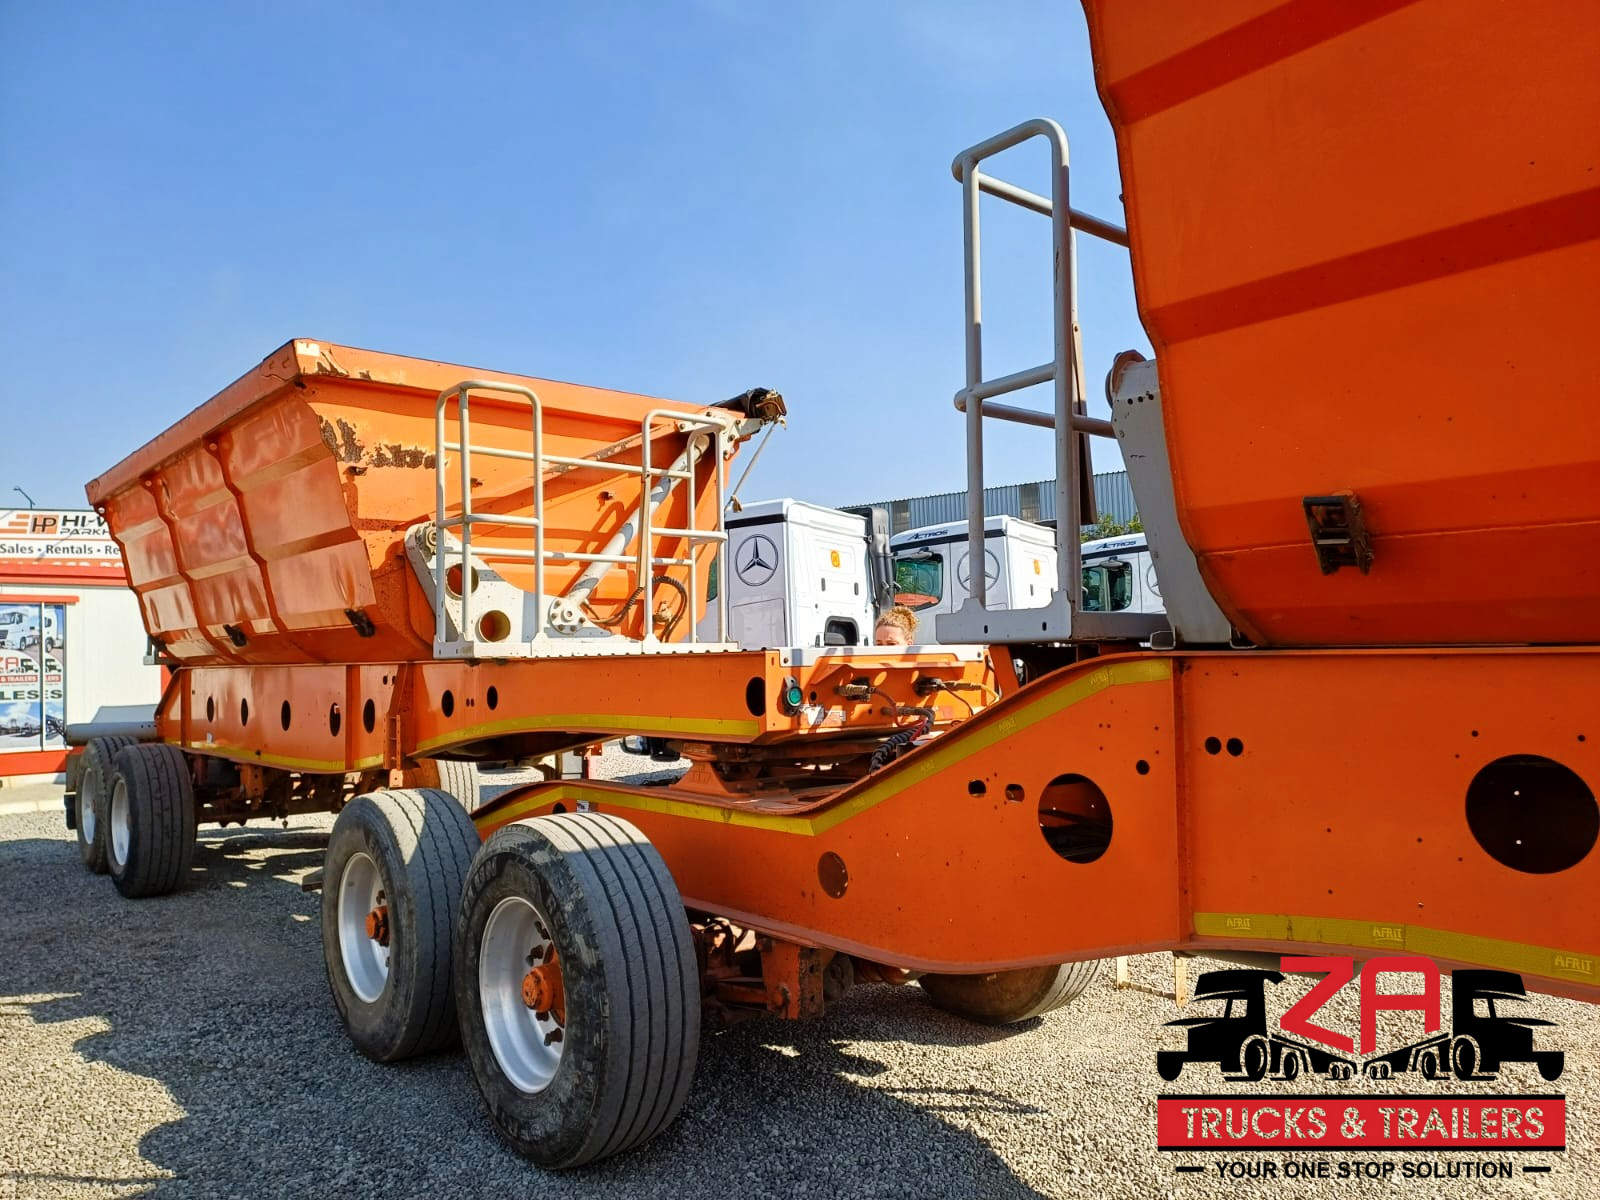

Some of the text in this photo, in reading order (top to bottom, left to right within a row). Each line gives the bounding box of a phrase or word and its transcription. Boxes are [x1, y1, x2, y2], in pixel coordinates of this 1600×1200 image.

[907, 529, 949, 541] ACTROS
[0, 543, 34, 554] Sales
[46, 544, 94, 555] Rentals
[1226, 917, 1252, 930] AFRIT
[1372, 926, 1403, 941] AFRIT
[1554, 955, 1593, 973] AFRIT
